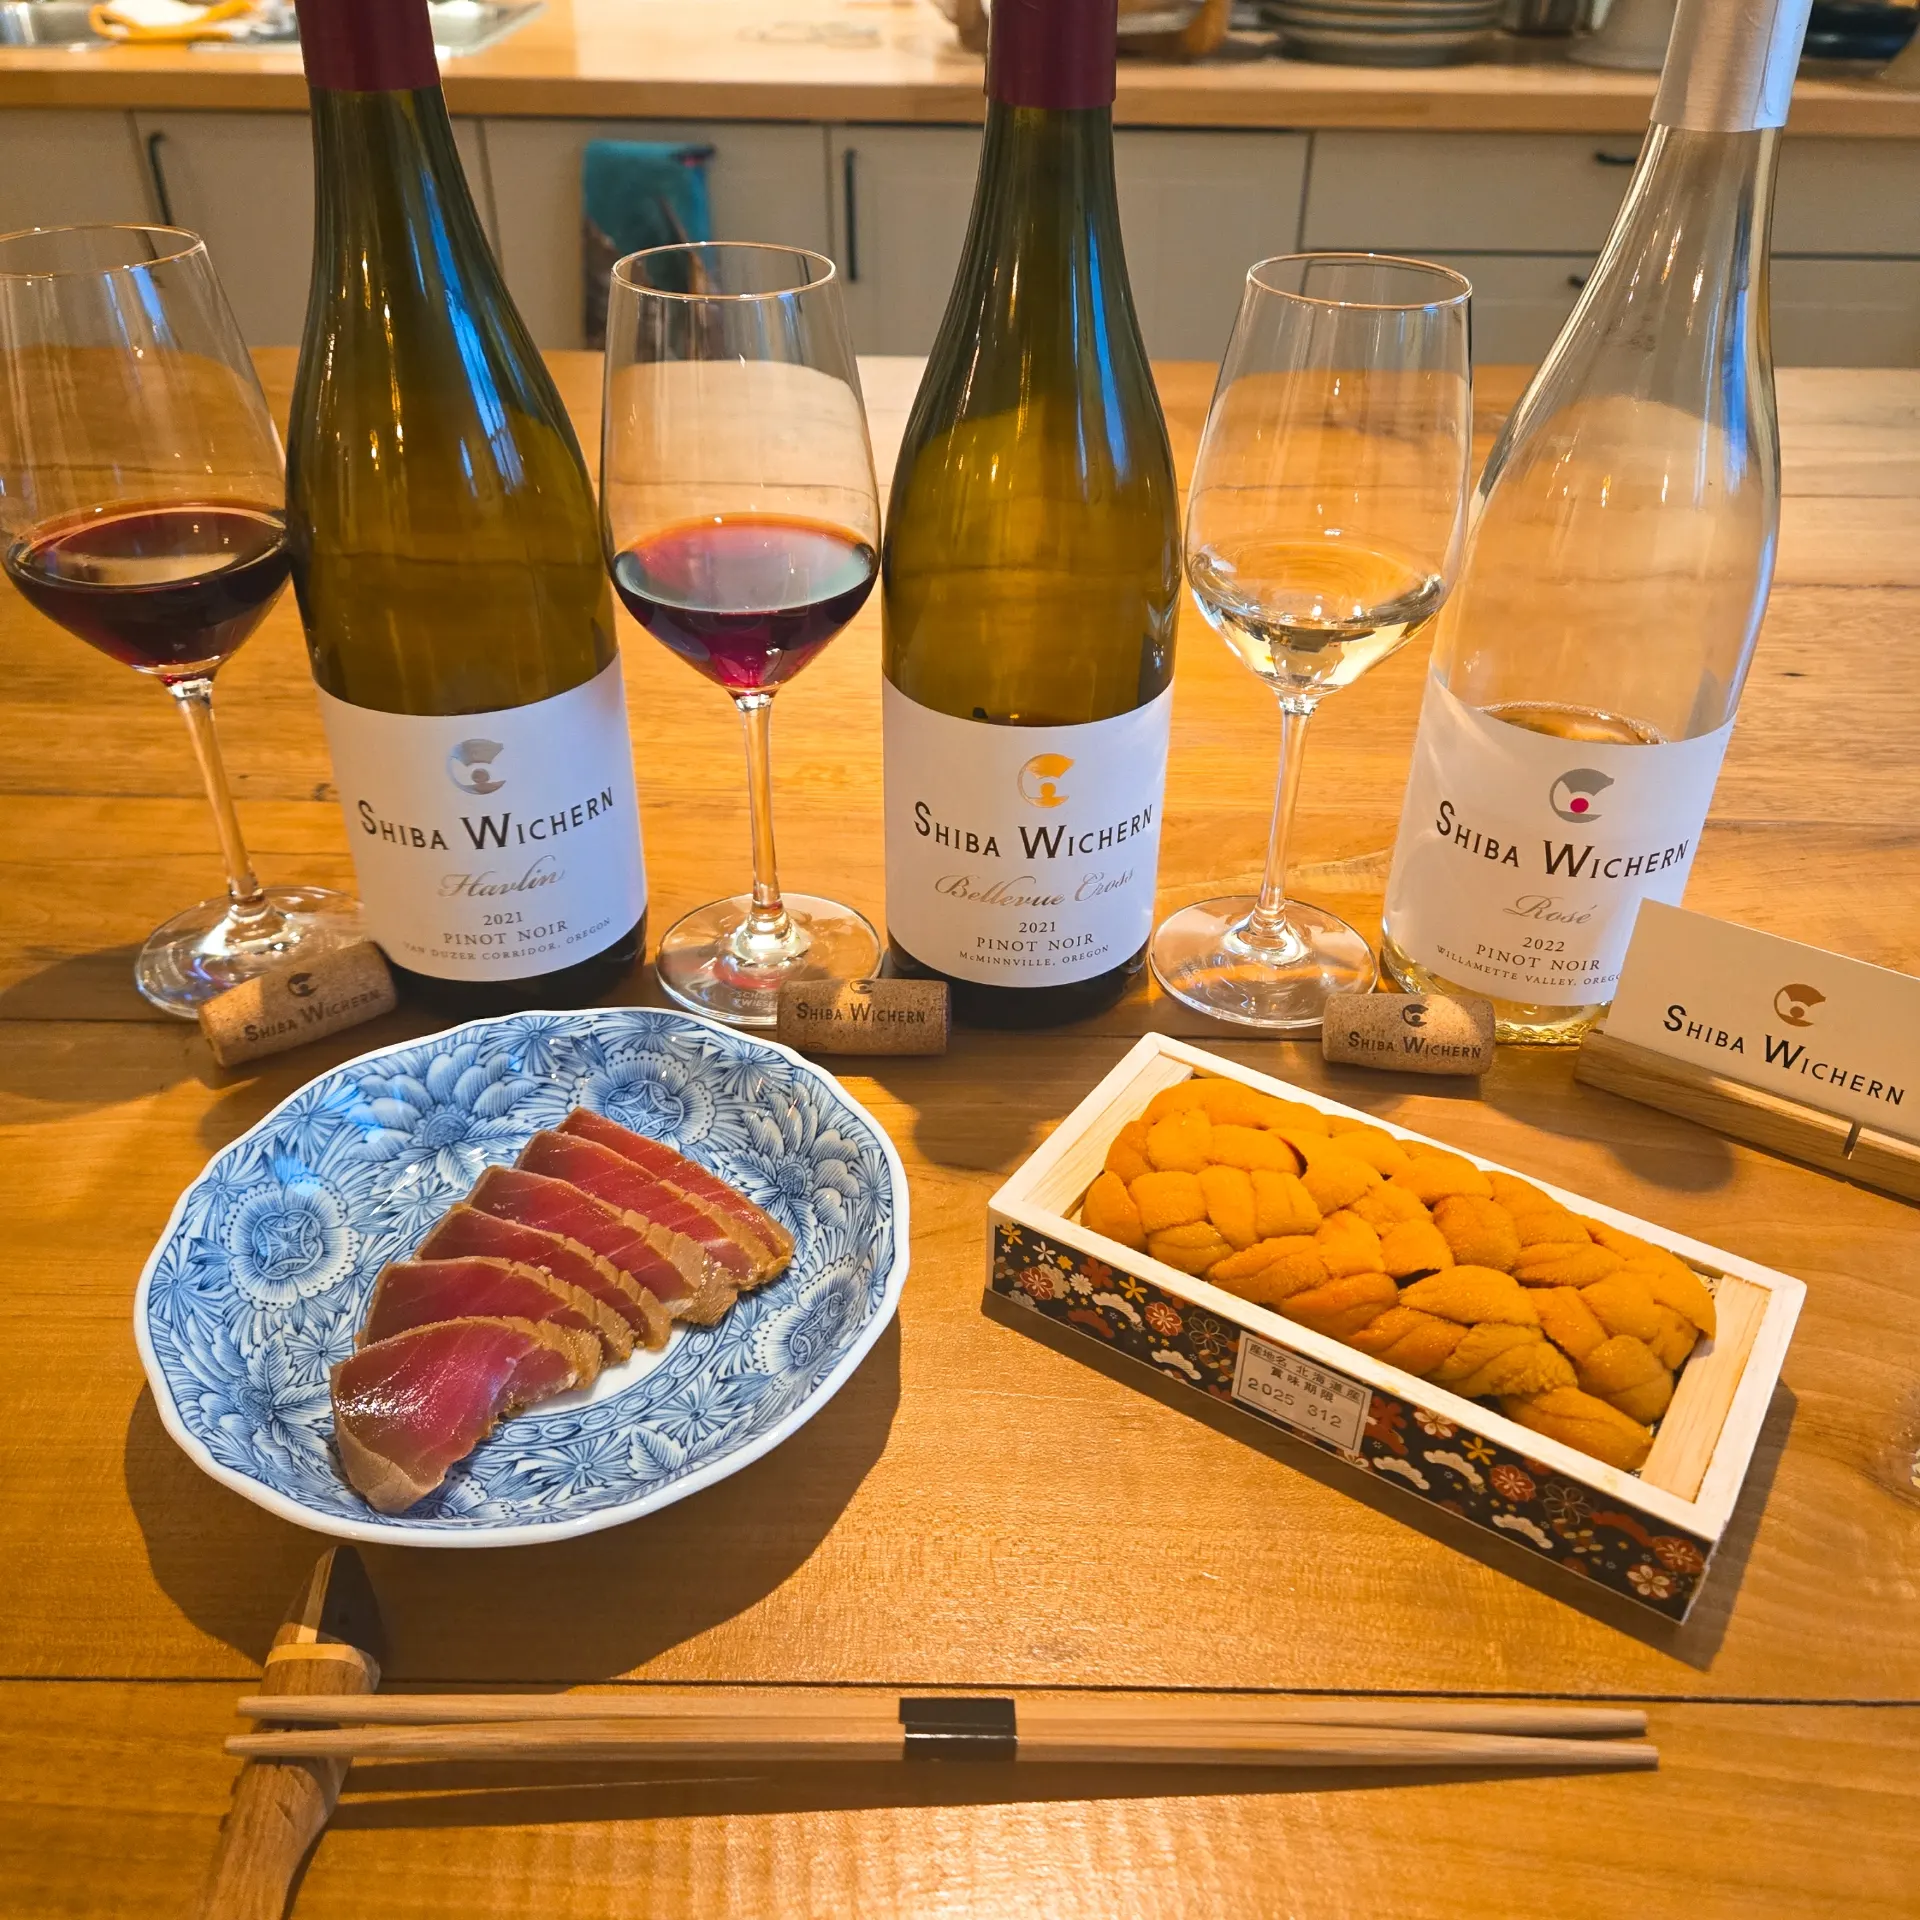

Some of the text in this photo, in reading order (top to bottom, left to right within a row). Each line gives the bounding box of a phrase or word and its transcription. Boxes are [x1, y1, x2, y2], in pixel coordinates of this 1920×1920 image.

[357, 786, 614, 850] SHIBA WICHERN
[914, 800, 1153, 859] SHIBA WICHERN
[1435, 800, 1689, 880] SHIBA WICHERN
[437, 854, 566, 898] Havlin
[934, 867, 1135, 907] Bellevue Cross
[482, 911, 524, 926] 2021
[1502, 894, 1598, 924] Rosé
[431, 949, 478, 961] DUZER
[482, 942, 562, 961] CORRIDOR,
[565, 917, 612, 945] OREGON
[443, 920, 569, 946] PINOT NOIR
[1018, 921, 1057, 934] 2021
[976, 933, 1095, 953] PINOT NOIR
[1061, 944, 1110, 964] OREGON
[1476, 944, 1601, 972] PINOT NOIR
[1522, 937, 1565, 953] 2022
[1436, 944, 1519, 981] WILLAMETTE
[1524, 974, 1578, 987] VALLEY,
[795, 1002, 925, 1024] SHIBA WICHERN
[1348, 1031, 1482, 1059] SHIBA WICHERN
[1662, 1004, 1906, 1106] SHIBA WICHERN
[1247, 1377, 1342, 1428] 2025 312
